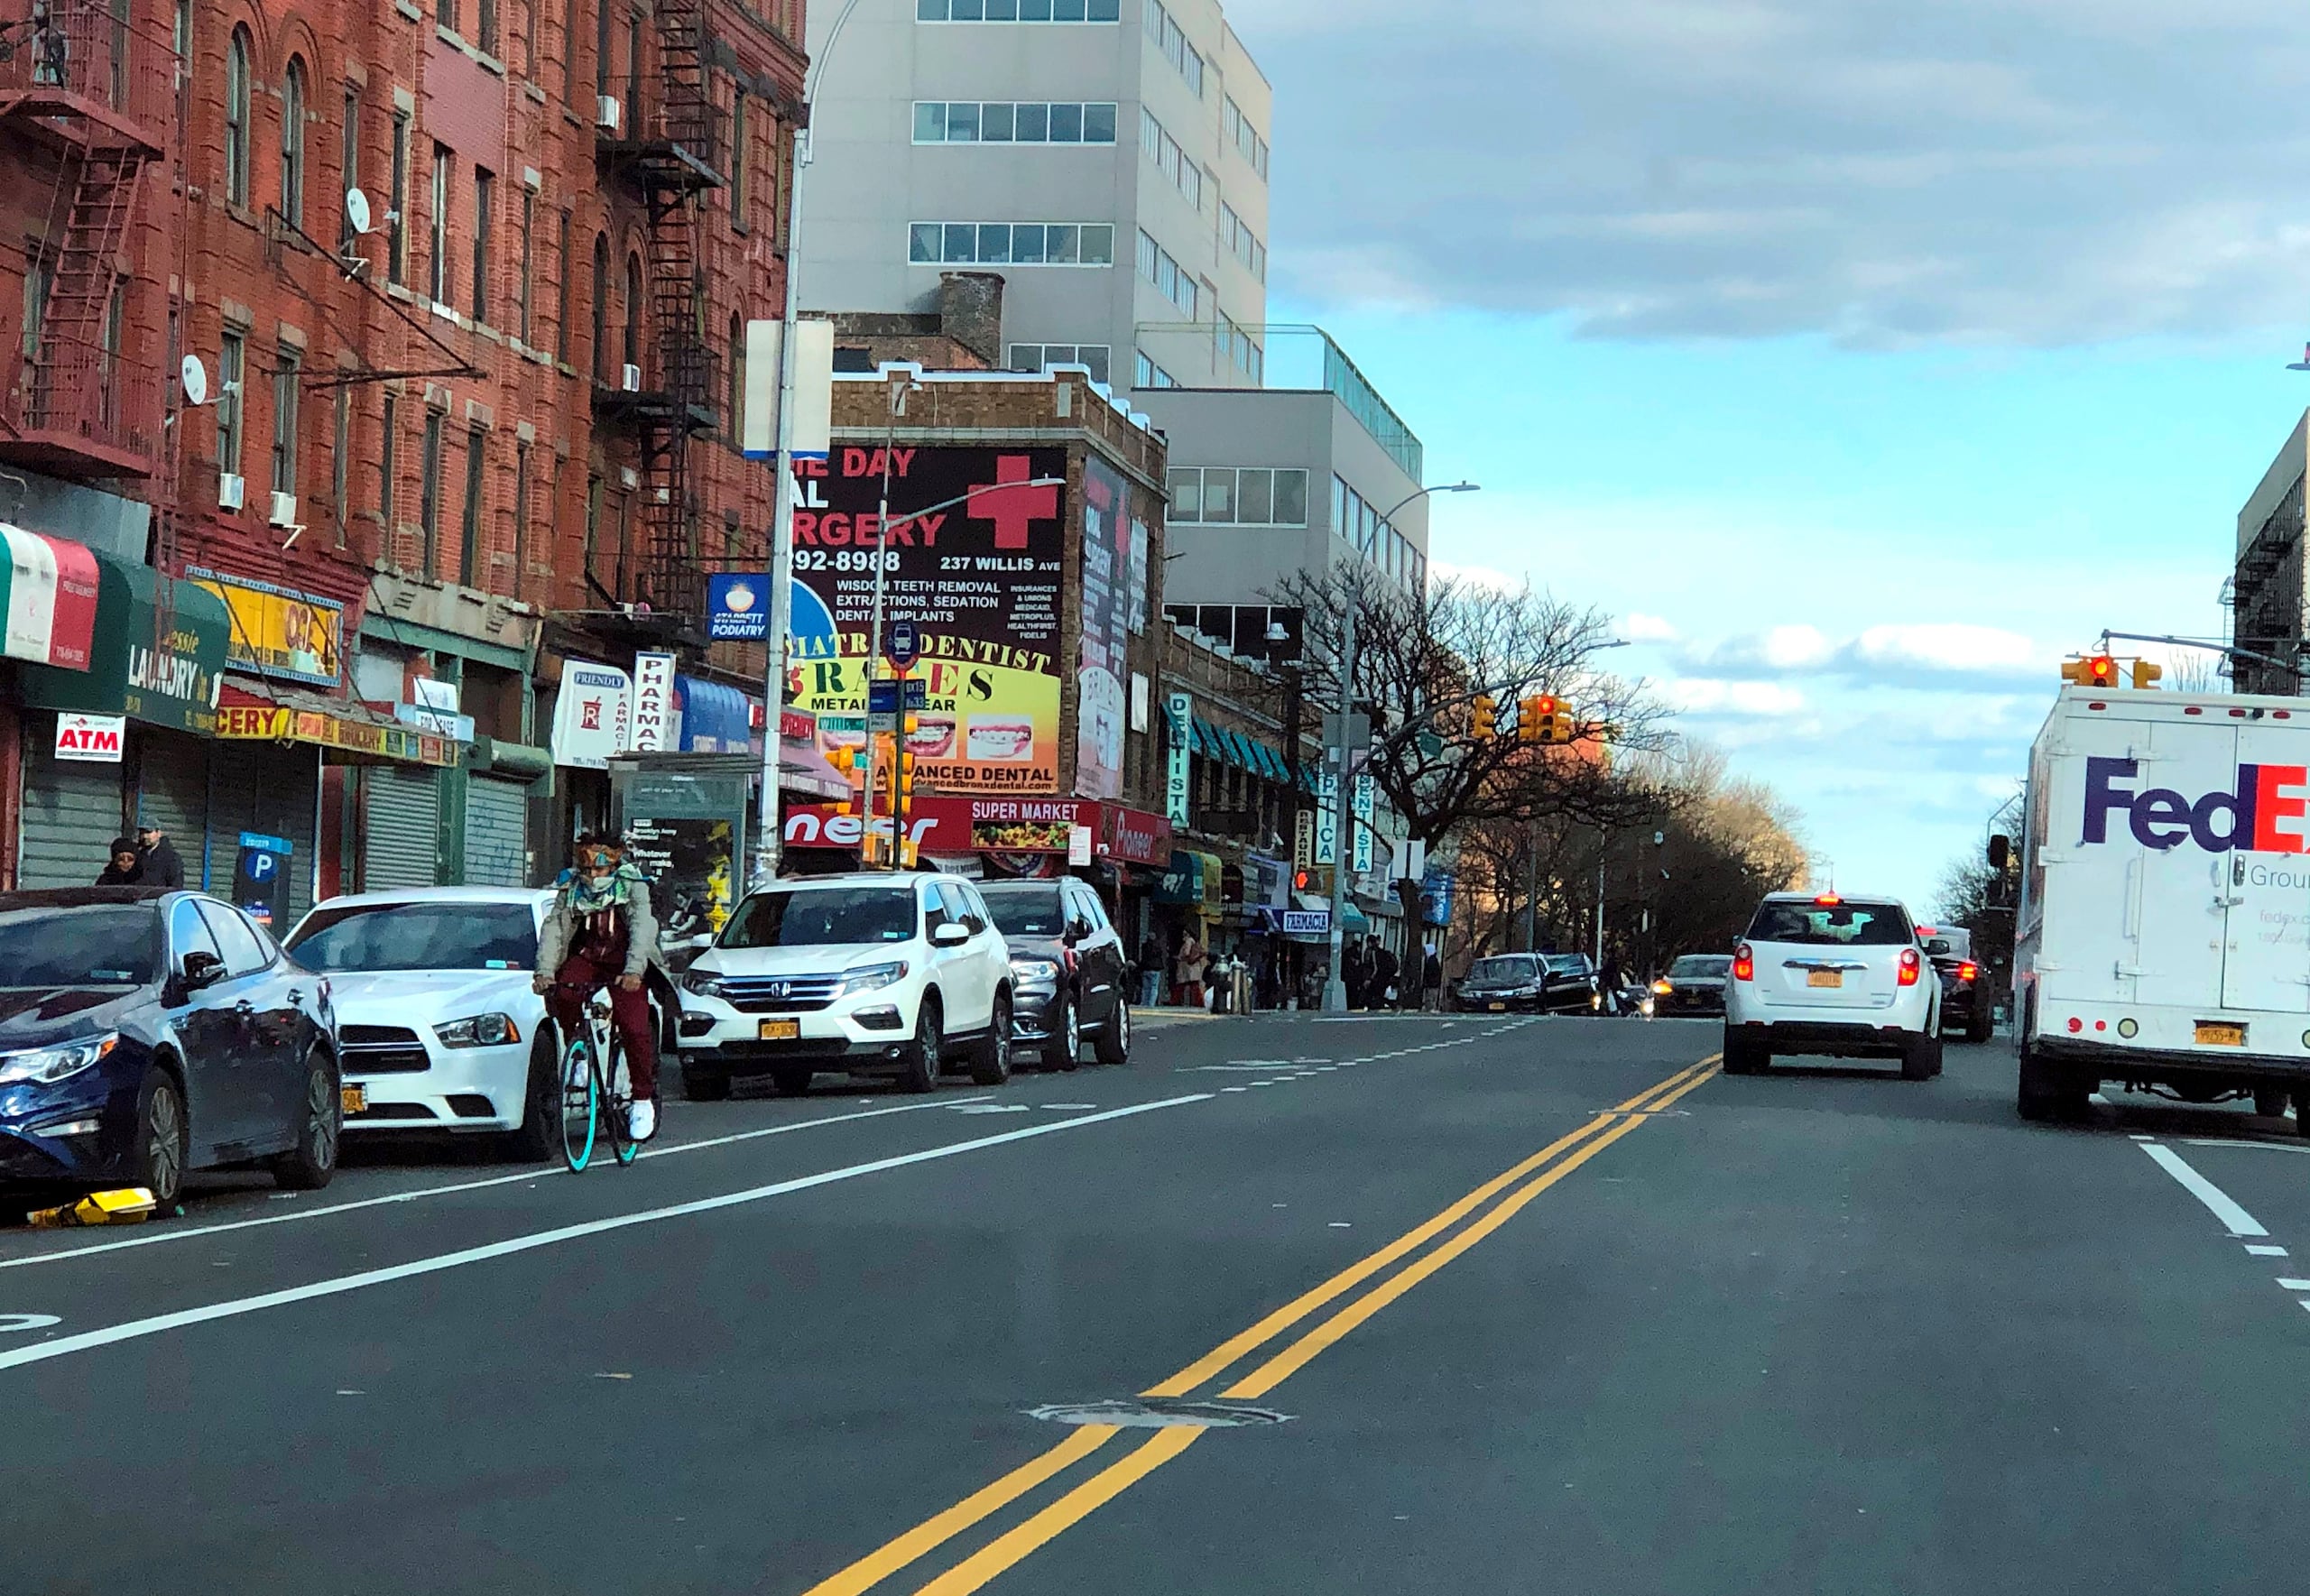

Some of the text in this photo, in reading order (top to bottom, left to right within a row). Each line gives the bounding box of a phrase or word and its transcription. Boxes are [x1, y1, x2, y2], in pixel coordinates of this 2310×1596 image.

[843, 447, 916, 477] DAY
[790, 549, 901, 572] 92-8988
[940, 557, 1061, 571] 237 WILLIS AVE
[836, 580, 1002, 594] WISDOM TEETH REMOVAL
[1010, 585, 1058, 593] INSURANCES
[933, 595, 999, 608] SEDATION
[890, 610, 955, 623] IMPLANTS
[711, 624, 765, 636] PODIATRY
[919, 632, 1051, 674] DENTIST
[128, 643, 199, 701] LAUNDRY
[577, 672, 624, 688] FRIENDLY
[58, 729, 119, 752] ATM
[876, 766, 1054, 782] AANCED DENTAL
[972, 801, 1079, 820] SUPER MARKET
[2083, 756, 2310, 854] FedE
[255, 853, 273, 878] P
[2250, 863, 2310, 889] Grou
[1286, 914, 1327, 932] FARMACIA
